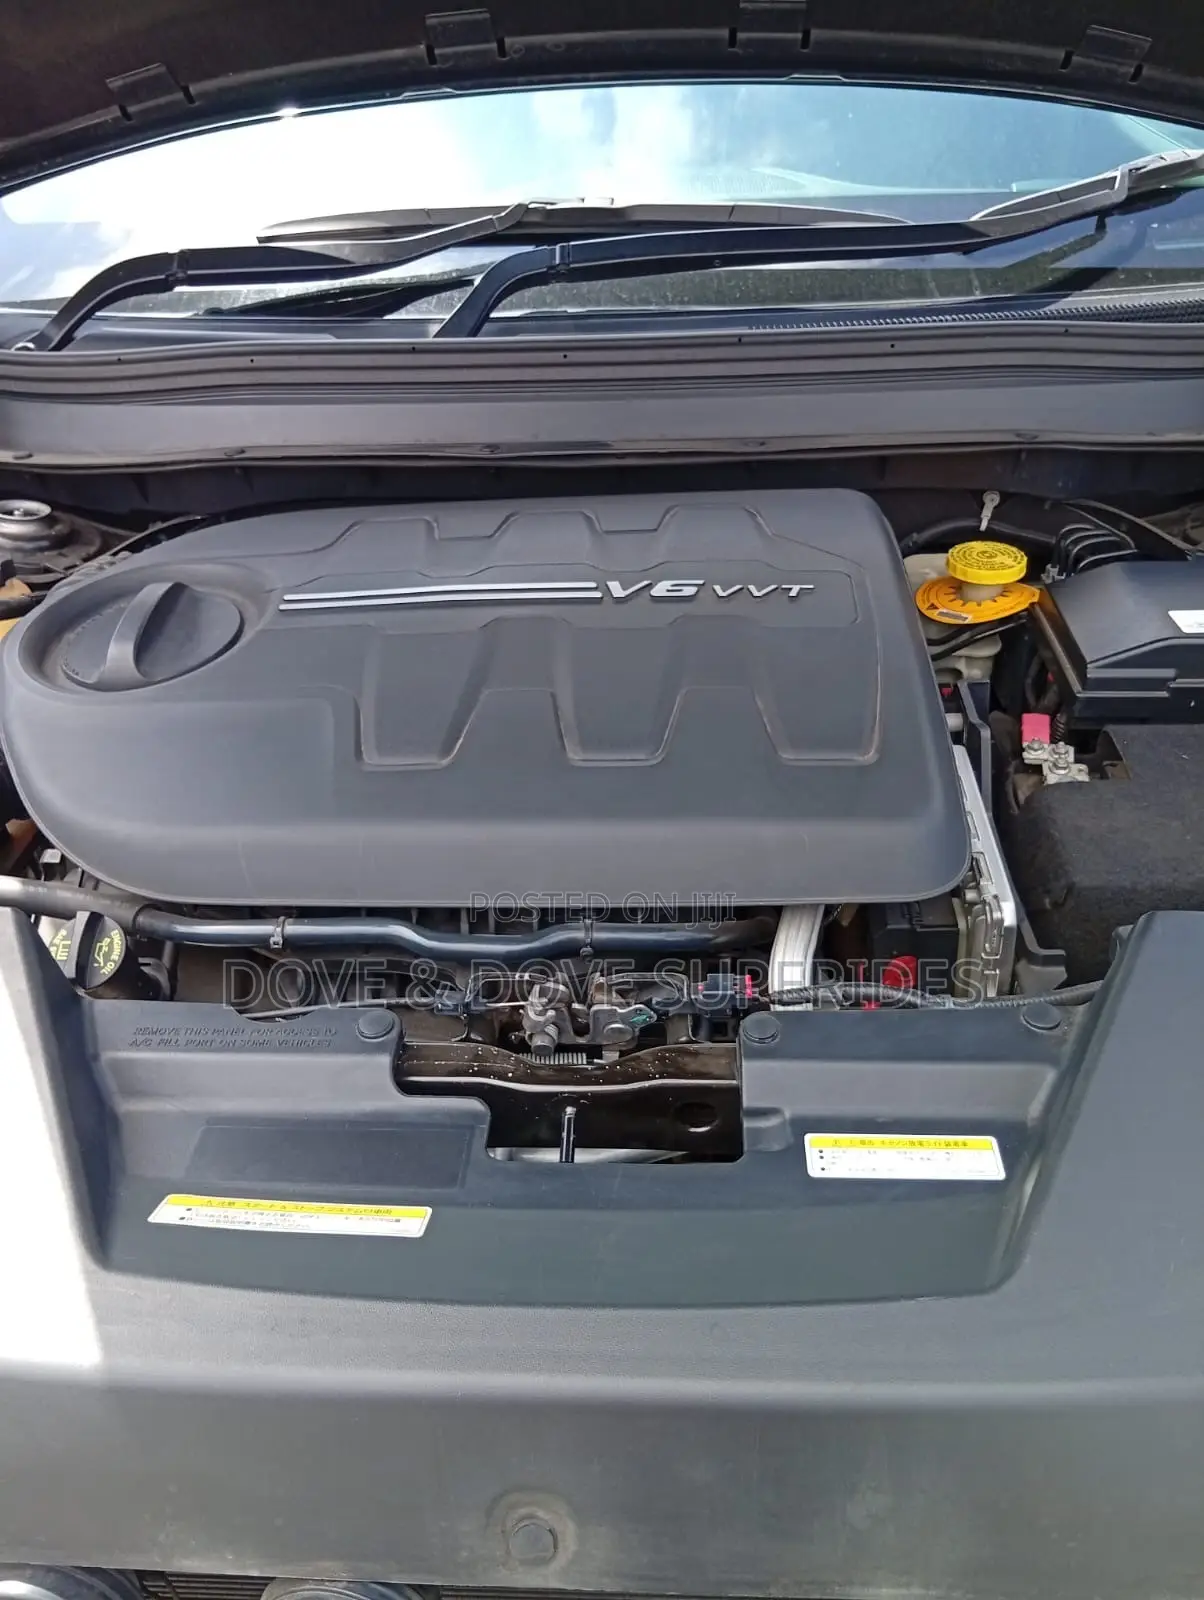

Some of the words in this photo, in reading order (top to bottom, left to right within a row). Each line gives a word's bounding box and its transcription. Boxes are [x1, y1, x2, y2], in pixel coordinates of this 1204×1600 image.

[606, 580, 705, 598] V6
[713, 584, 814, 597] VVT
[110, 929, 122, 961] ENGINE
[100, 961, 115, 975] OIL
[134, 1027, 181, 1036] REMOVE
[183, 1027, 209, 1036] THIS
[128, 1038, 153, 1048] A/C
[157, 1038, 181, 1048] FILL
[184, 1039, 214, 1048] PORT
[218, 1039, 237, 1048] ON
[240, 1039, 270, 1049] SOME
